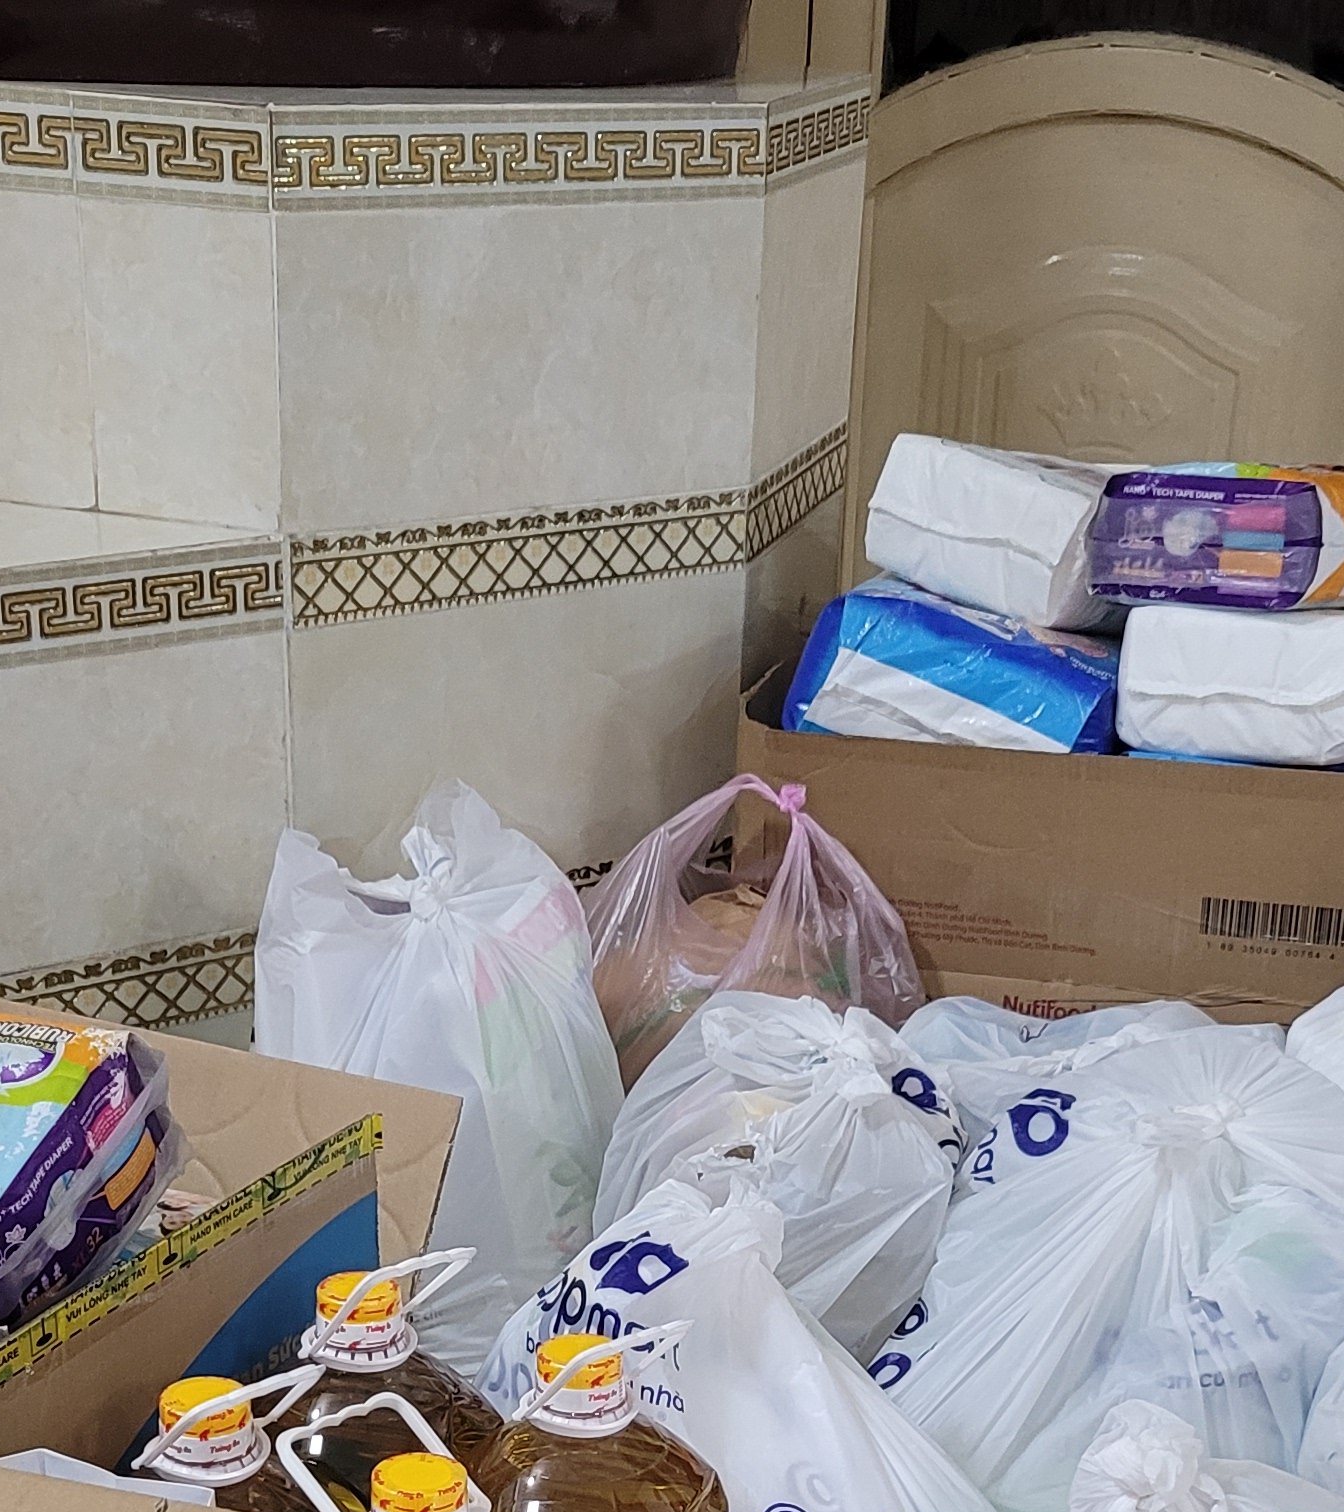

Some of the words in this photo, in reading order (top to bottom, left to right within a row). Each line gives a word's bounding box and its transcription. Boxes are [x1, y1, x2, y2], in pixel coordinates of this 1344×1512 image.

[346, 1135, 365, 1155] TAY
[8, 1189, 35, 1217] TECH
[28, 1163, 52, 1194] TAPE
[42, 1136, 75, 1174] DIAPER
[85, 1226, 104, 1250] 32
[189, 1222, 212, 1246] HAND
[211, 1210, 233, 1233] WITH
[231, 1198, 256, 1223] CARE
[64, 1306, 84, 1324] VUI
[83, 1288, 110, 1316] LÒNG
[109, 1276, 131, 1300] NHẸ
[129, 1264, 149, 1287] TAY
[639, 1384, 686, 1414] nhà
